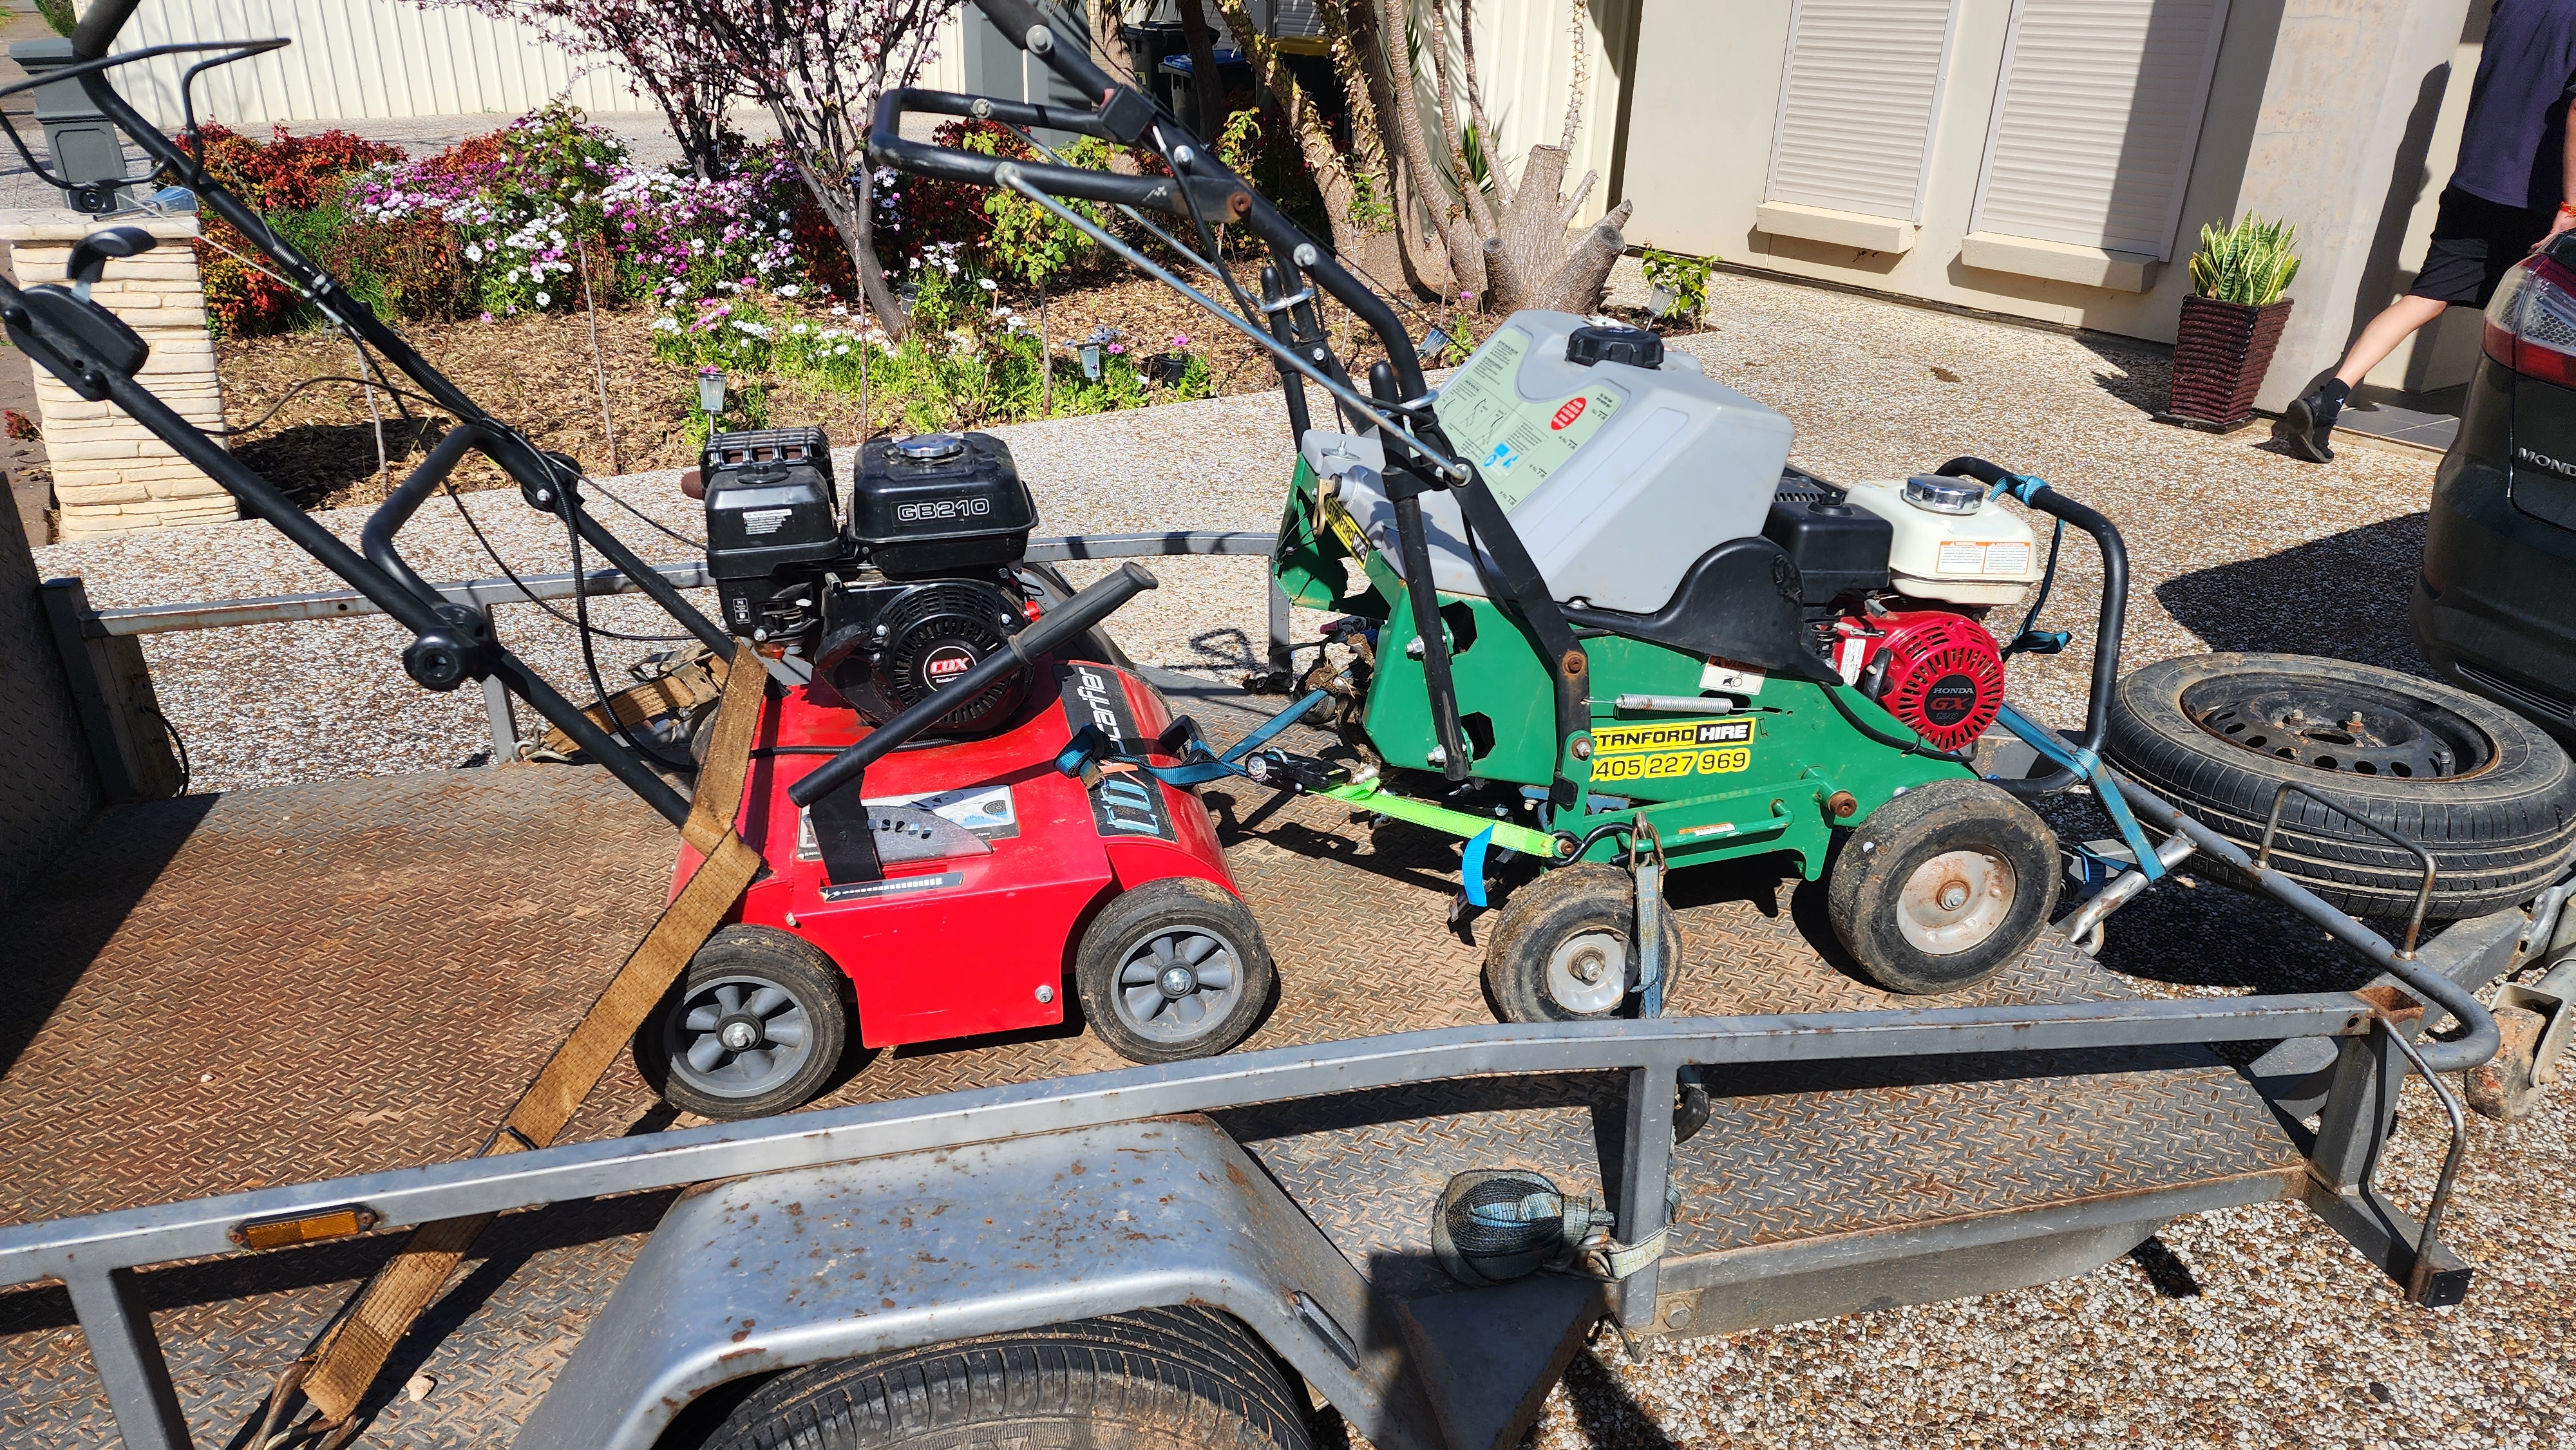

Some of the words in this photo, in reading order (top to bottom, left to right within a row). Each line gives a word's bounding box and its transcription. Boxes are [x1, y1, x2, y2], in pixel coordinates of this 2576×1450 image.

[2518, 447, 2576, 476] MOND
[897, 498, 990, 521] GB210
[1328, 505, 1354, 543] STANFORD
[930, 657, 970, 675] COX
[1930, 697, 1970, 710] GX
[1700, 724, 1748, 741] HIRE
[1591, 758, 1641, 777] 405
[1649, 755, 1694, 774] 227
[1702, 751, 1746, 770] 969
[1098, 759, 1160, 835] COX
